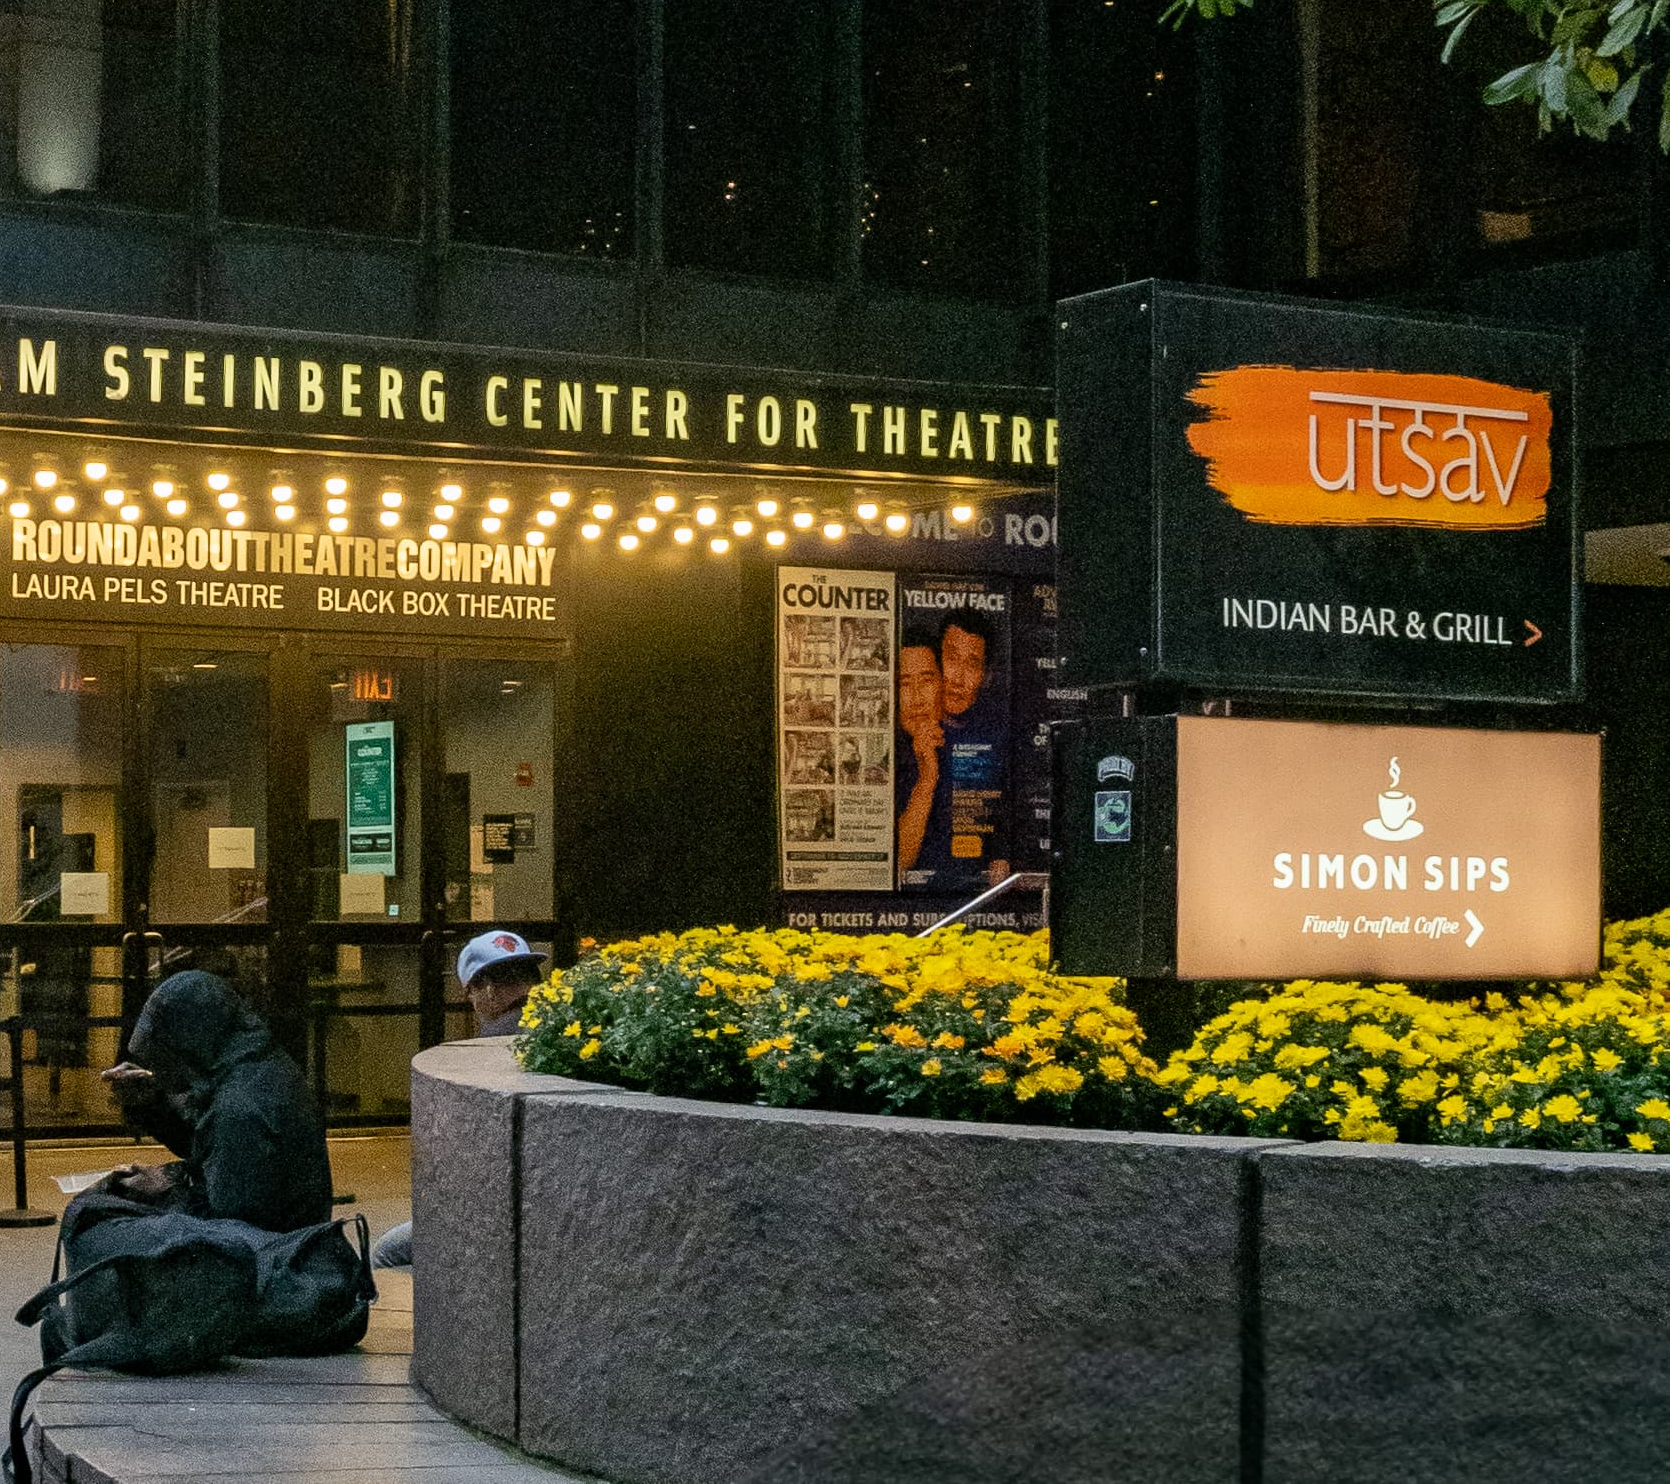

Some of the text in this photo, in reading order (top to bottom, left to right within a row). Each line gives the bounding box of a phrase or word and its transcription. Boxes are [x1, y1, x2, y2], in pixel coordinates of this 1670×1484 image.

[103, 344, 445, 424] STEINBERG
[485, 375, 689, 441] CENTER
[726, 393, 819, 450] FOR
[850, 403, 1058, 466] THEATRE
[1309, 391, 1528, 505] utsav
[812, 574, 826, 584] THE
[12, 573, 556, 620] LAURA PELS THEATRE BLACK BOX THEATRE
[783, 583, 891, 612] COUNTER
[904, 589, 1005, 612] YELLOW FACE
[1223, 597, 1513, 645] INDIAN BAR & GRILL
[1047, 689, 1087, 701] ENGLISH
[1273, 852, 1510, 892] SIMON SIPS
[789, 912, 816, 927] FOR
[822, 912, 873, 927] TICKETS
[879, 913, 908, 927] AND
[1302, 915, 1460, 939] Finely Crafted Coffee
